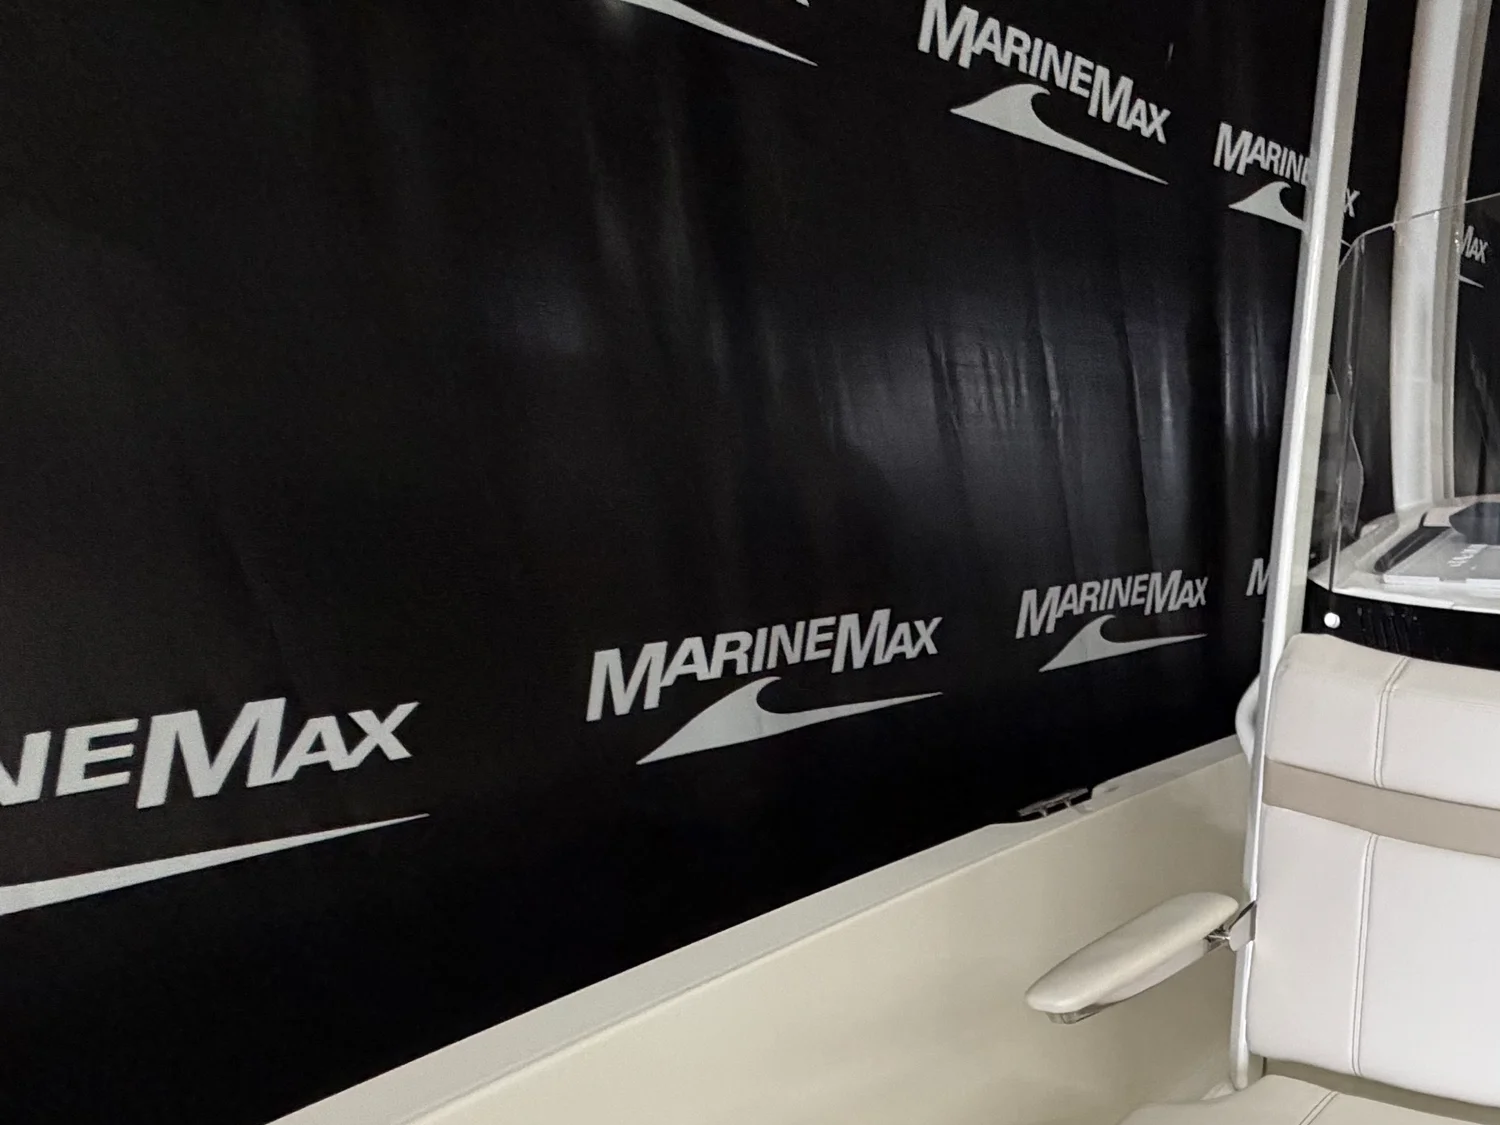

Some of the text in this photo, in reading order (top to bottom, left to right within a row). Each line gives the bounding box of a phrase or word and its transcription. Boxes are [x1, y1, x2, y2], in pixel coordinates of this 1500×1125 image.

[918, 0, 1171, 144] MARINEMAX
[1213, 122, 1361, 218] MARINX
[1015, 570, 1209, 640] MARINEMAX
[586, 609, 942, 722] MARINEMAX
